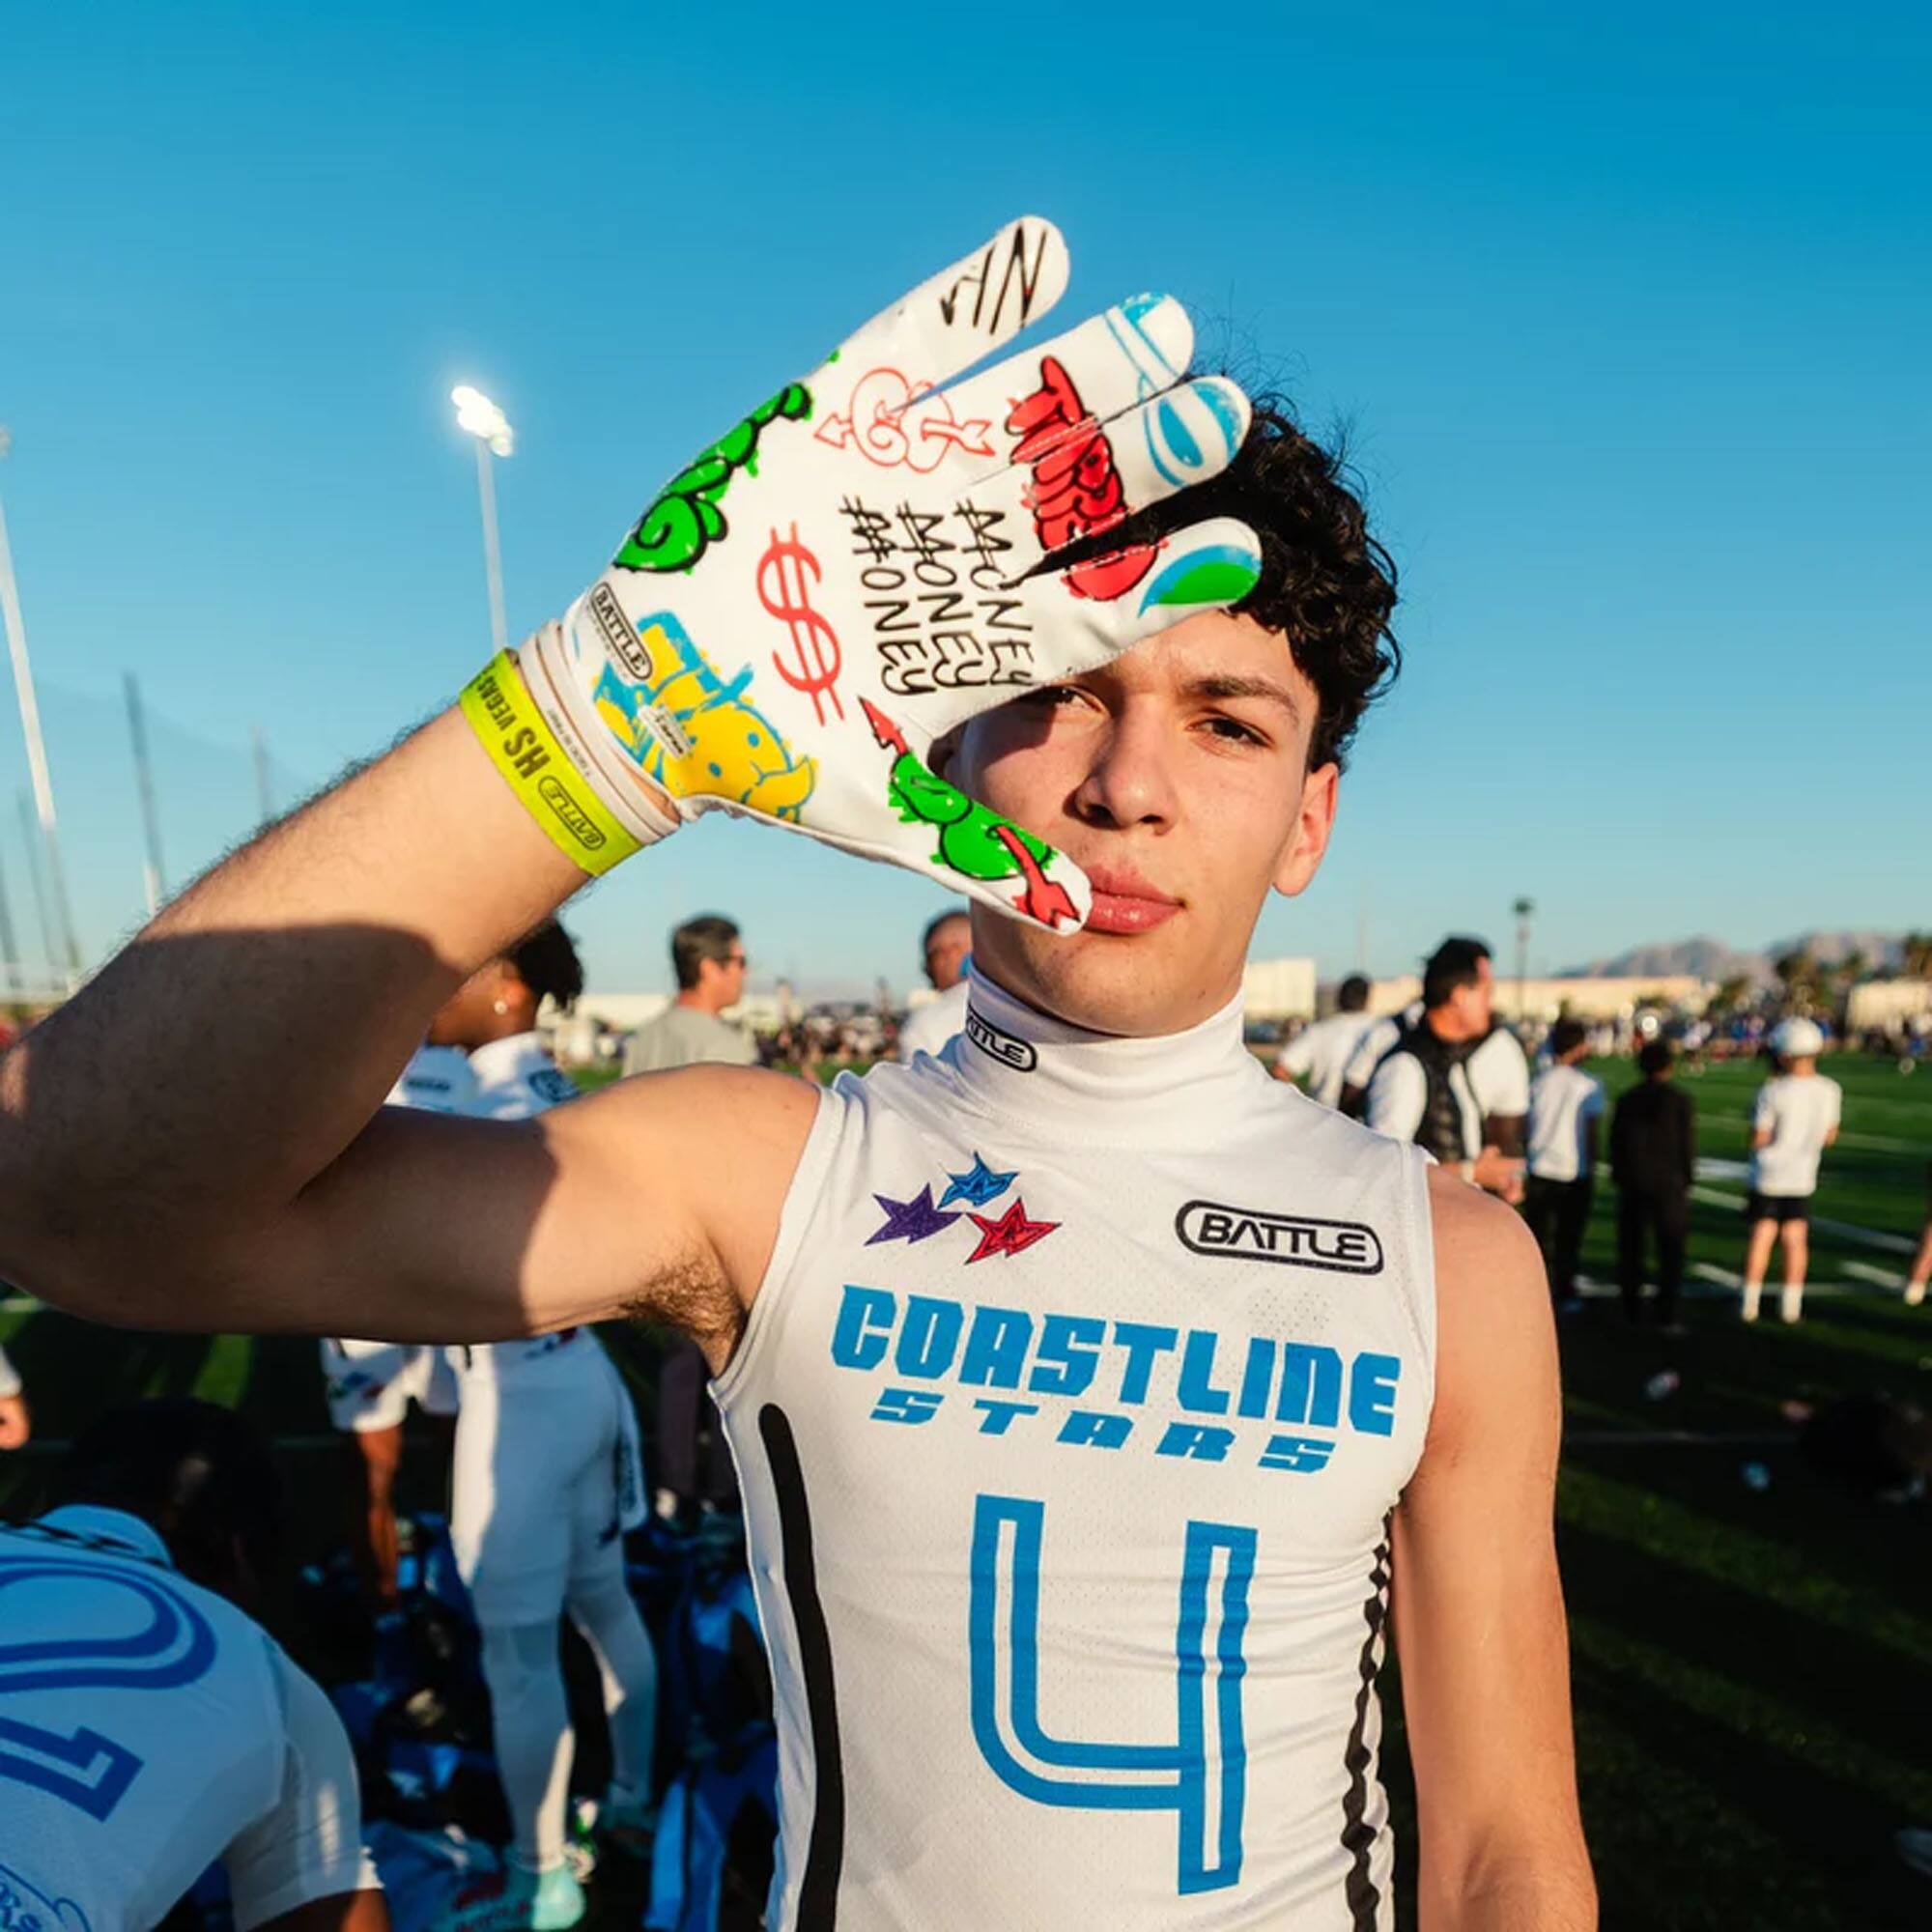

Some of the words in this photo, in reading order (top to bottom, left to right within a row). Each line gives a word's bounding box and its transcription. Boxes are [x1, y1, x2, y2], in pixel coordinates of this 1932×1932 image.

[594, 588, 646, 672] BATTLE
[480, 675, 516, 730] VEGAS
[503, 726, 551, 780] HS
[548, 786, 599, 846] BATTLE
[967, 1016, 1025, 1064] TTLE
[1198, 1212, 1370, 1264] BATTLE
[830, 1284, 1403, 1437] COASTLINE
[869, 1387, 1337, 1475] STARS
[969, 1493, 1258, 1895] 4
